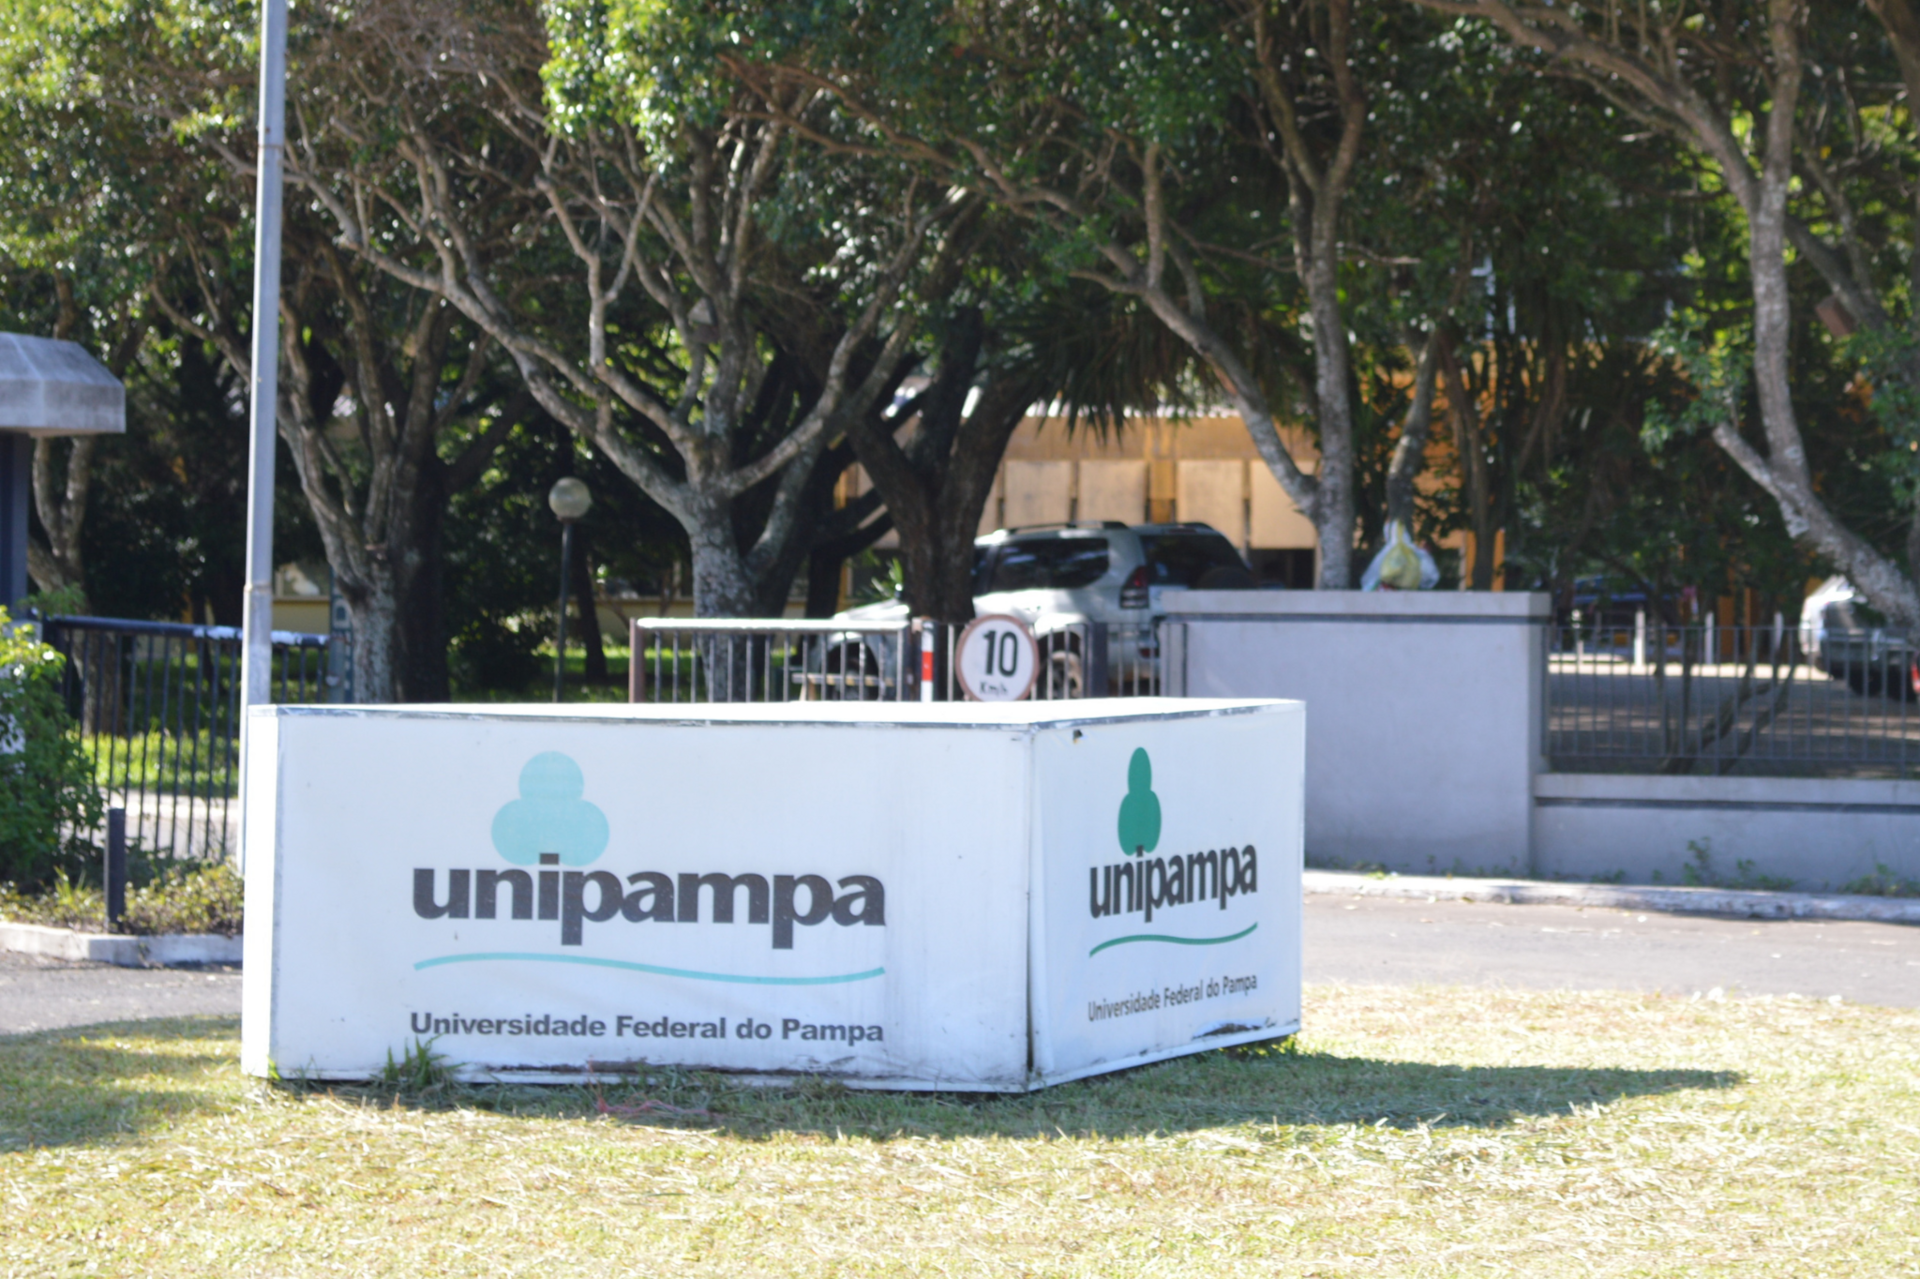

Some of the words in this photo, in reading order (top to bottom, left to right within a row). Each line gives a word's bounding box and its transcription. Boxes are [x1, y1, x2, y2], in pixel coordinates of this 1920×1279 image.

[983, 630, 1018, 677] 10
[413, 853, 886, 949] unipampa
[1090, 845, 1257, 923] unipampa
[1088, 988, 1160, 1021] Universidade
[1164, 979, 1203, 1007] Federal
[1206, 977, 1220, 998] do
[1223, 974, 1257, 996] Pampa
[410, 1012, 606, 1036] Universidade
[616, 1015, 726, 1038] Federal
[736, 1018, 772, 1039] do
[782, 1018, 884, 1046] Pampa
